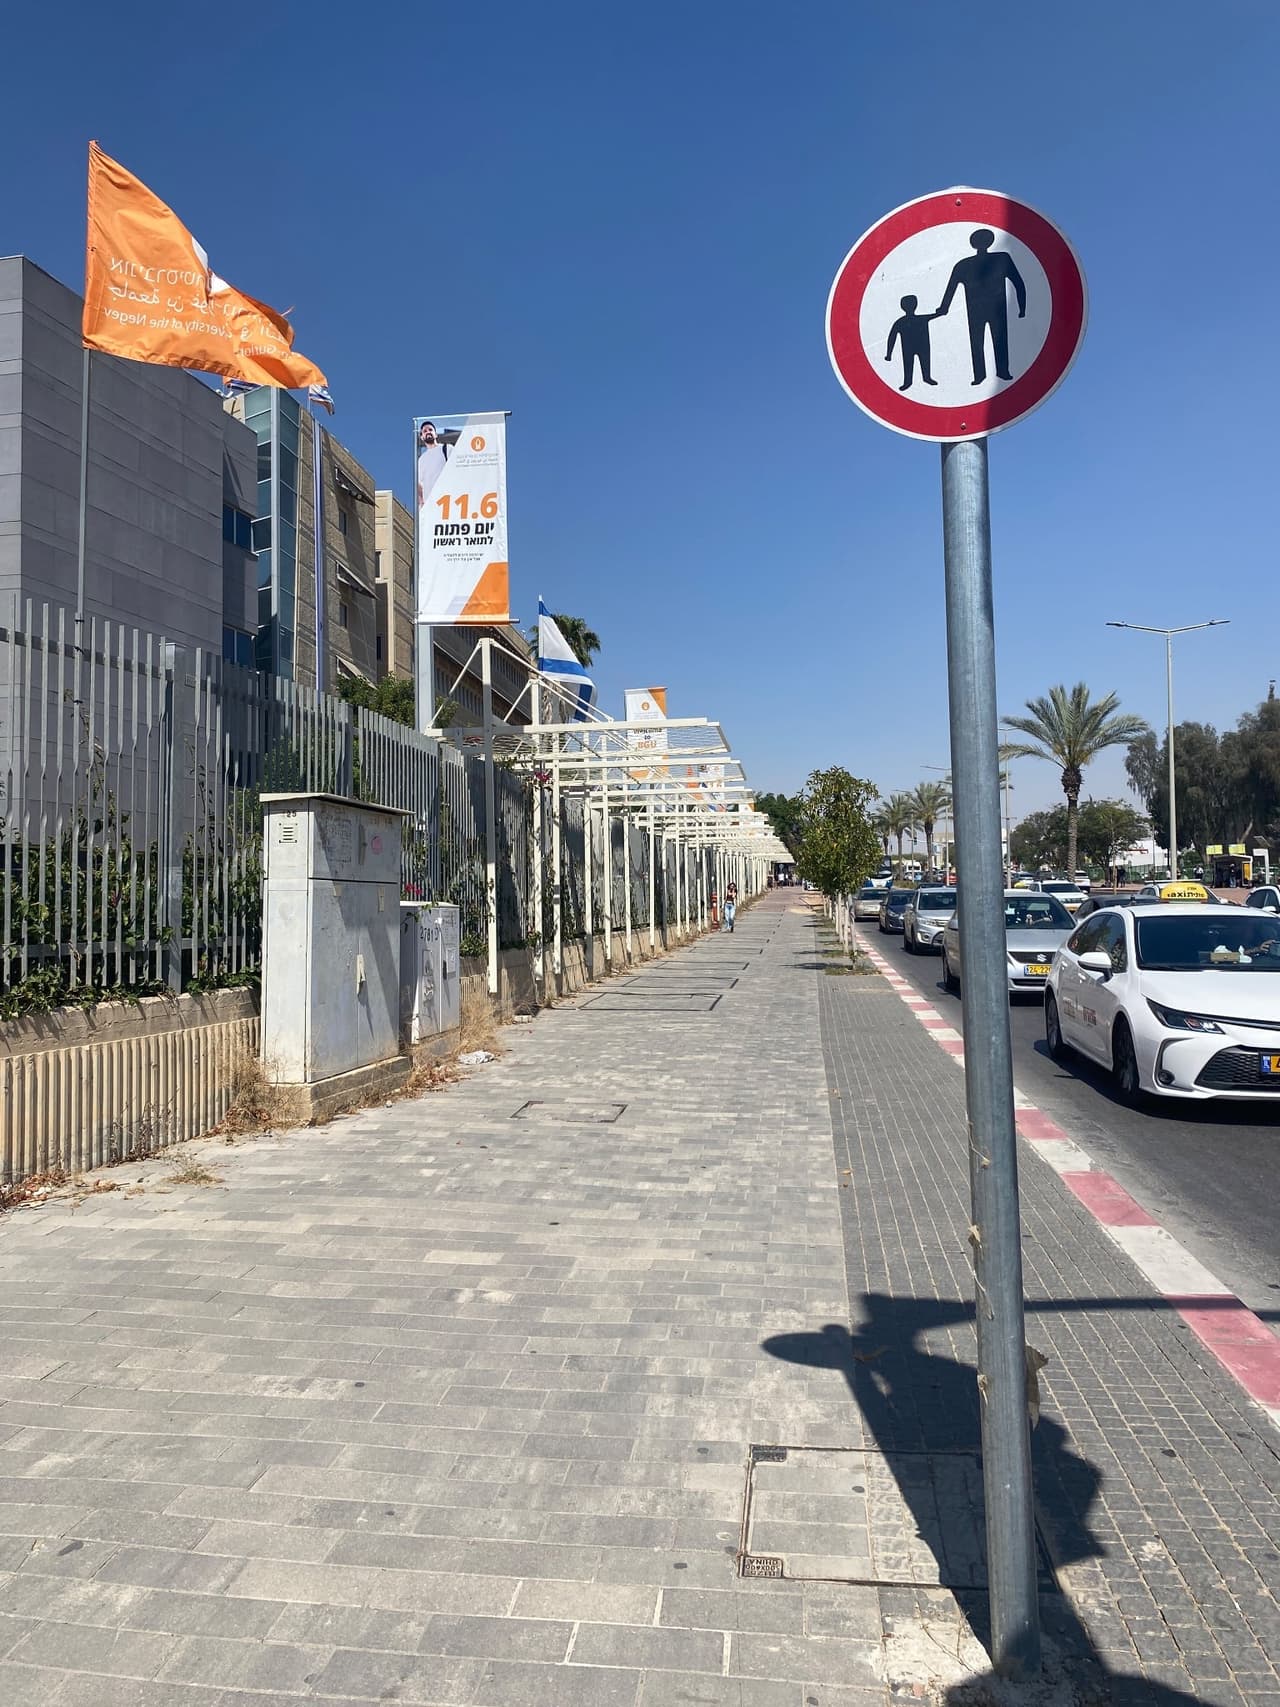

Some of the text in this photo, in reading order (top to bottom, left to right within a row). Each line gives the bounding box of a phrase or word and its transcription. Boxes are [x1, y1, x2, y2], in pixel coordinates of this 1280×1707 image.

[436, 492, 498, 520] 11.6
[434, 522, 495, 536] יום פתוח
[433, 536, 494, 549] לתואר ראשון
